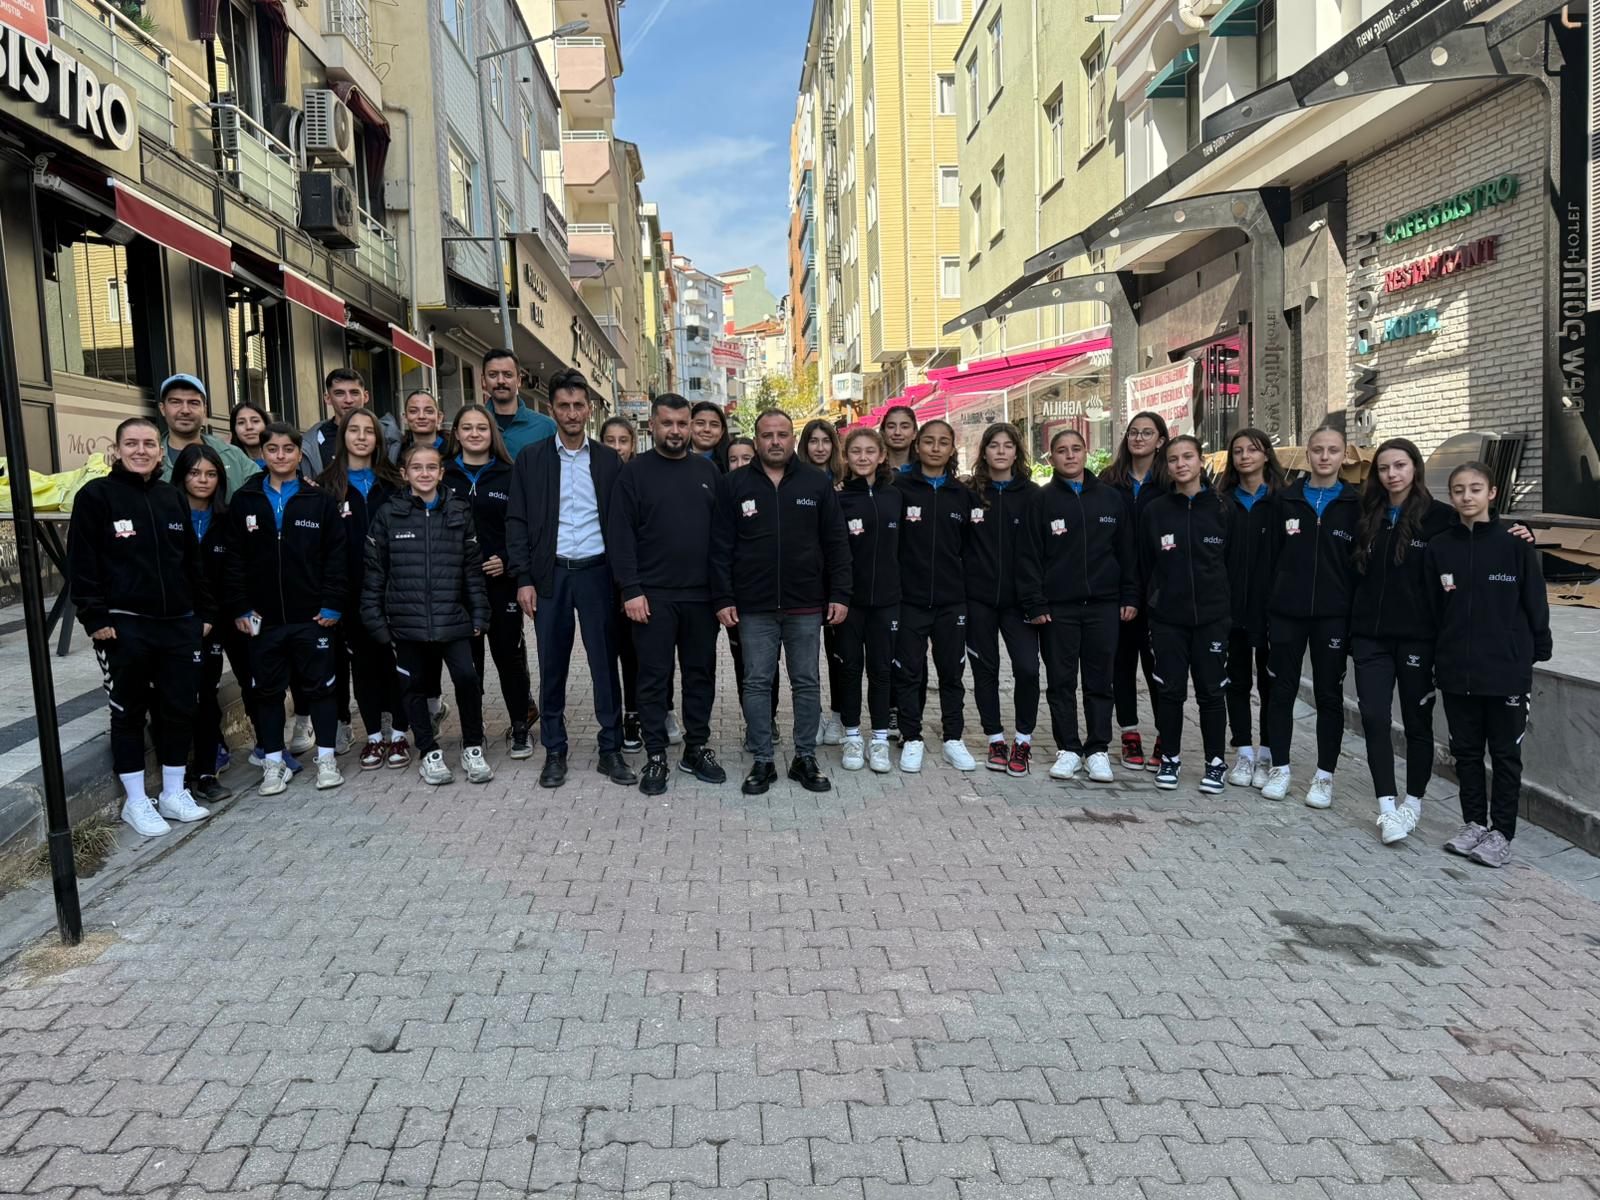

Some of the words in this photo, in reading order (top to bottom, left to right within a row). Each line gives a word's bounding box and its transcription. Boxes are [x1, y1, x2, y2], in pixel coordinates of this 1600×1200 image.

[1356, 29, 1374, 48] new
[1373, 9, 1396, 39] point
[1384, 209, 1427, 244] CAFE
[1441, 173, 1518, 225] BISTRO
[1384, 235, 1499, 294] RESTAURANT
[1383, 308, 1441, 342] HOTEL
[294, 518, 320, 529] addax
[1488, 572, 1517, 582] addax
